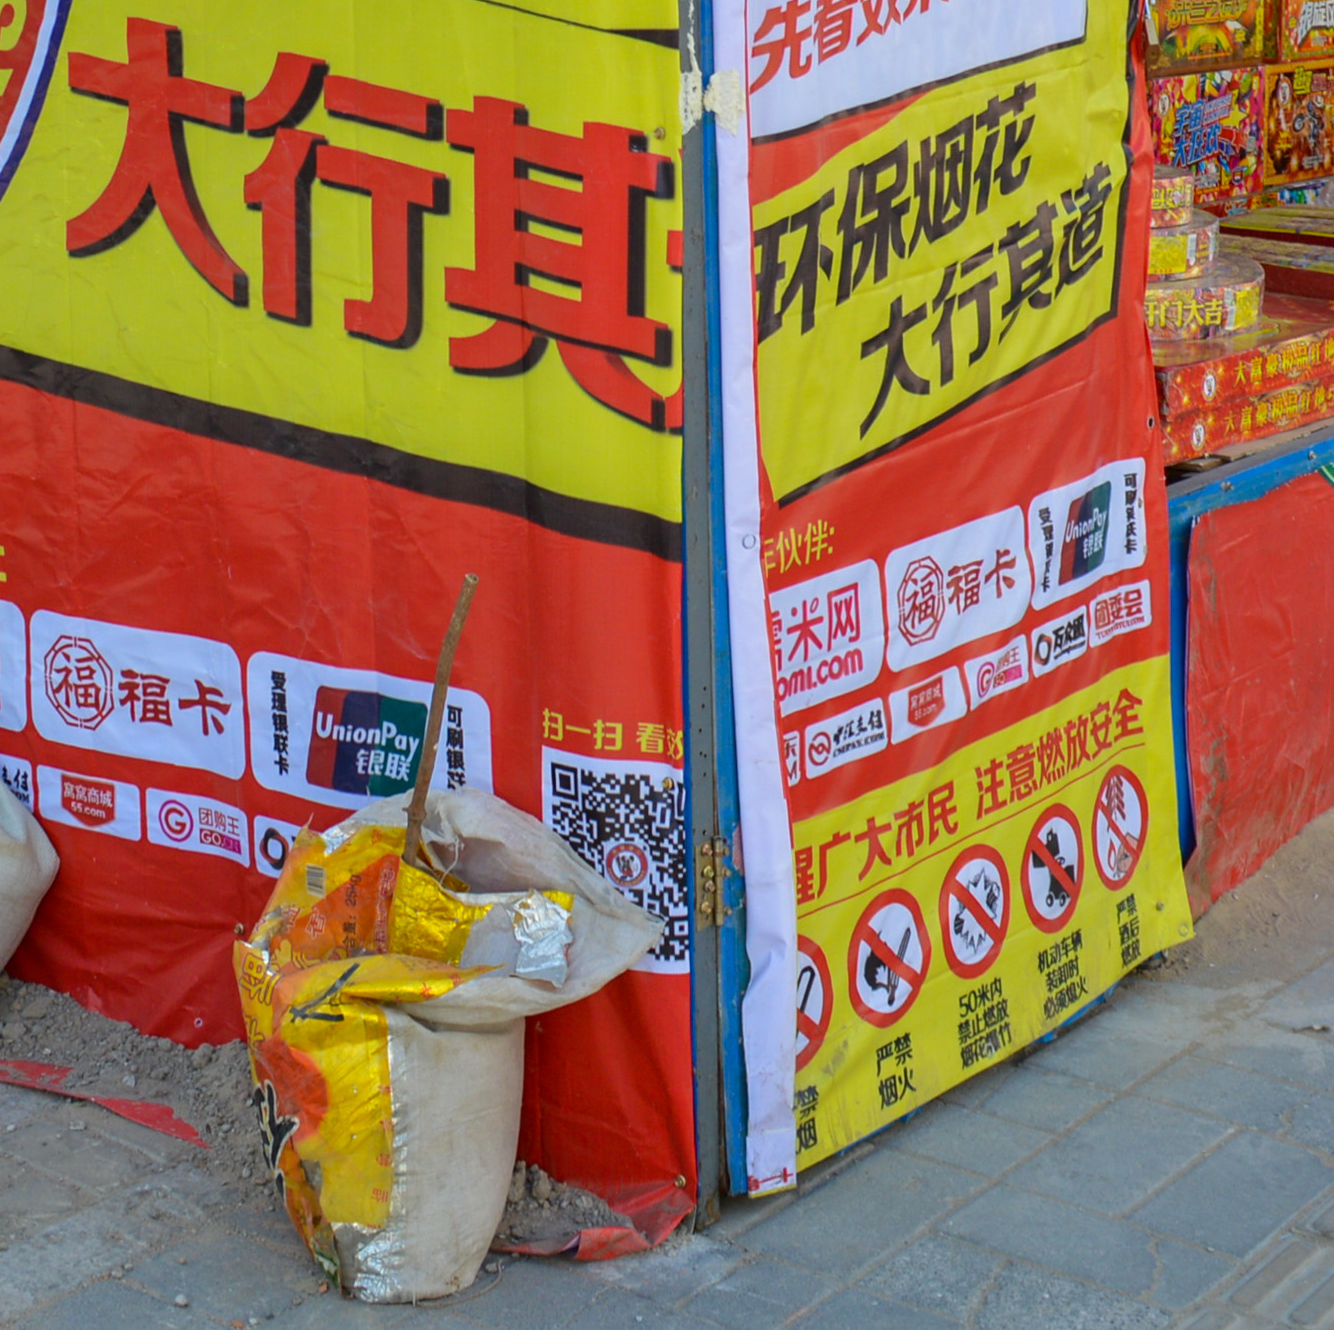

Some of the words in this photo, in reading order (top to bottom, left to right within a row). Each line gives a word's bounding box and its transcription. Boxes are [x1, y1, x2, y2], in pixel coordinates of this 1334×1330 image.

[753, 81, 1038, 346] 环保烟花
[859, 161, 1112, 441] 大行其道
[947, 548, 1017, 615] 福卡
[119, 667, 232, 737] 福卡
[270, 669, 290, 777] 受理银联卡
[316, 710, 420, 763] UnionPay
[542, 707, 623, 751] 扫一扫
[355, 748, 412, 782] 银联
[975, 686, 1145, 821] 注意燃放安全
[63, 780, 113, 808] 窝窝商城
[70, 801, 106, 819] 55.com
[198, 807, 240, 837] 团购王
[1116, 893, 1138, 925] 严禁
[1037, 928, 1083, 974] 机动车辆
[1045, 954, 1079, 993] 装卸时
[958, 977, 1001, 1018] 50米内
[1043, 975, 1089, 1020] 必须熄火
[955, 998, 1009, 1045] 禁止燃放
[875, 1031, 913, 1077] 严禁
[877, 1066, 918, 1111] 烟火
